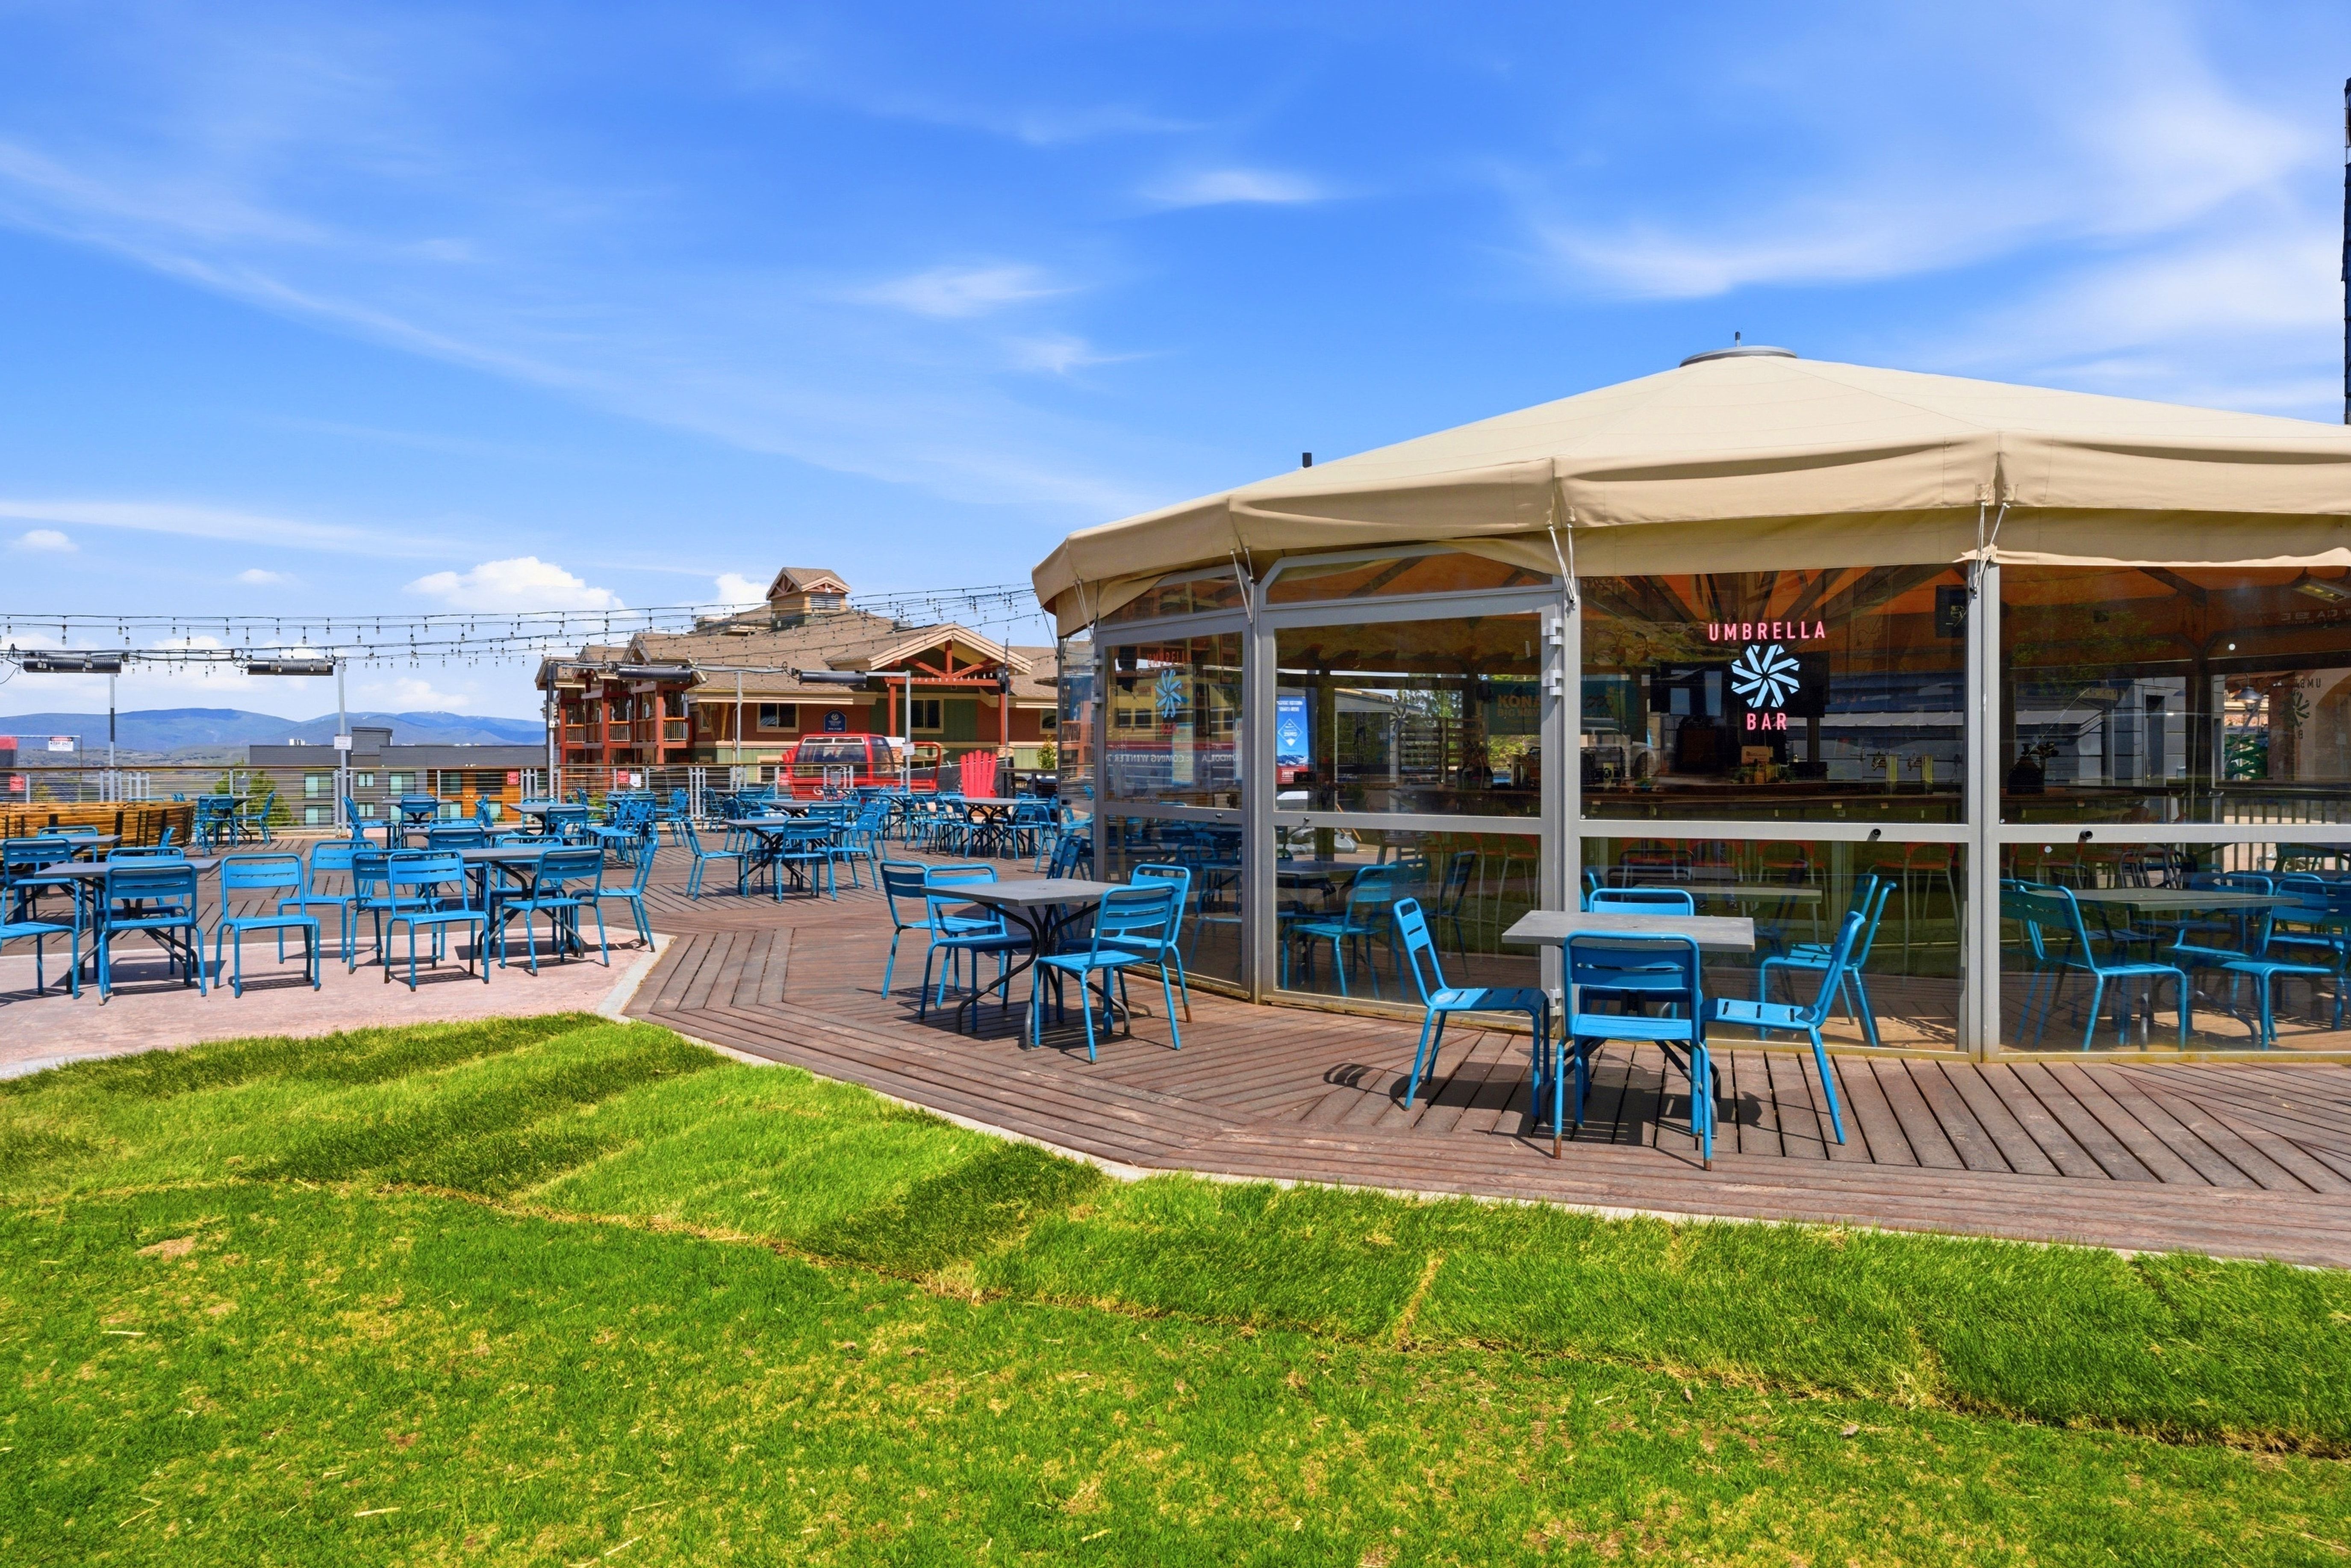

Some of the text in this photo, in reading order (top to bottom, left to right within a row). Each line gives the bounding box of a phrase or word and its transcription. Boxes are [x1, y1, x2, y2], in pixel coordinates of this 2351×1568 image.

[1709, 621, 1826, 641] UMBRELLA
[1147, 651, 1190, 666] UMRELL
[1518, 708, 1541, 716] WAV
[1746, 713, 1787, 730] BAR
